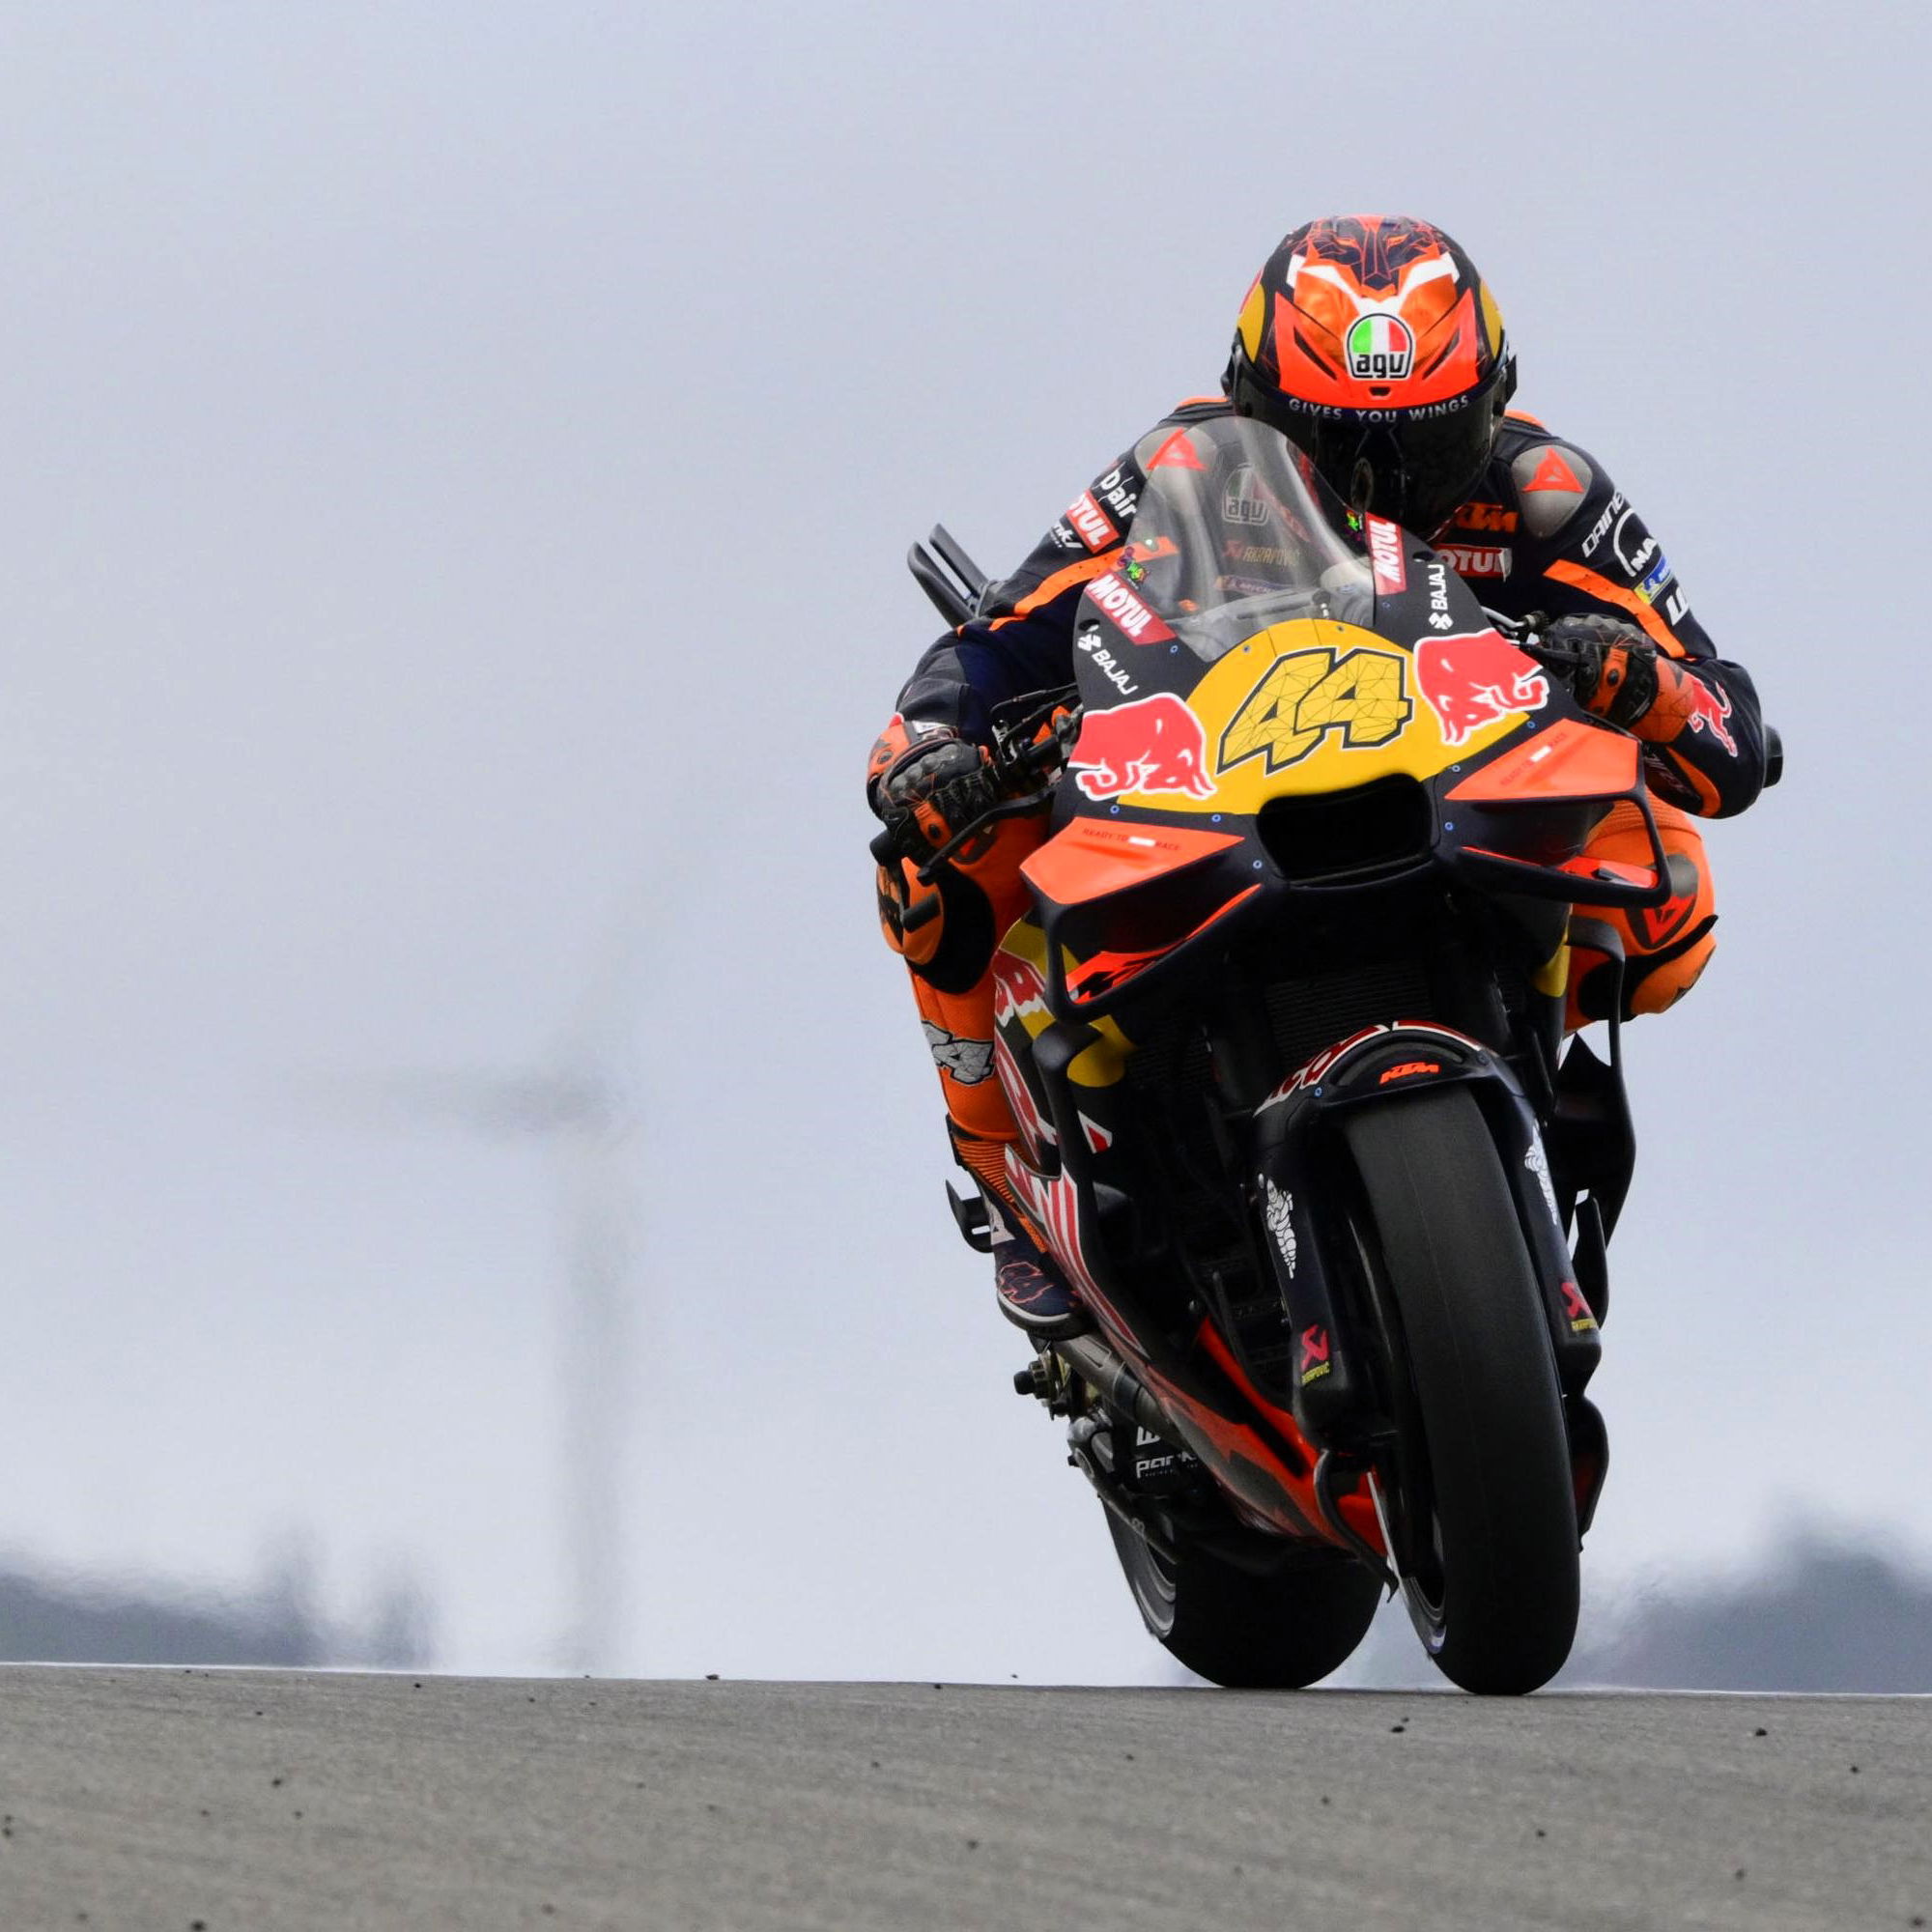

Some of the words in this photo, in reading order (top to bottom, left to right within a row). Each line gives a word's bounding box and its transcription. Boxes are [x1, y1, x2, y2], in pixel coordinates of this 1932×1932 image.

[1356, 354, 1406, 379] agv
[1289, 397, 1343, 420] GIVES
[1356, 410, 1397, 423] YOU
[1408, 394, 1470, 421] WINGS
[1369, 519, 1401, 583] MOTUL
[1086, 574, 1152, 638] MOTUL
[1428, 564, 1448, 611] BAJAJ
[1092, 649, 1139, 696] BAJAJ
[1216, 646, 1414, 776] 44
[1378, 1062, 1439, 1085] KTM
